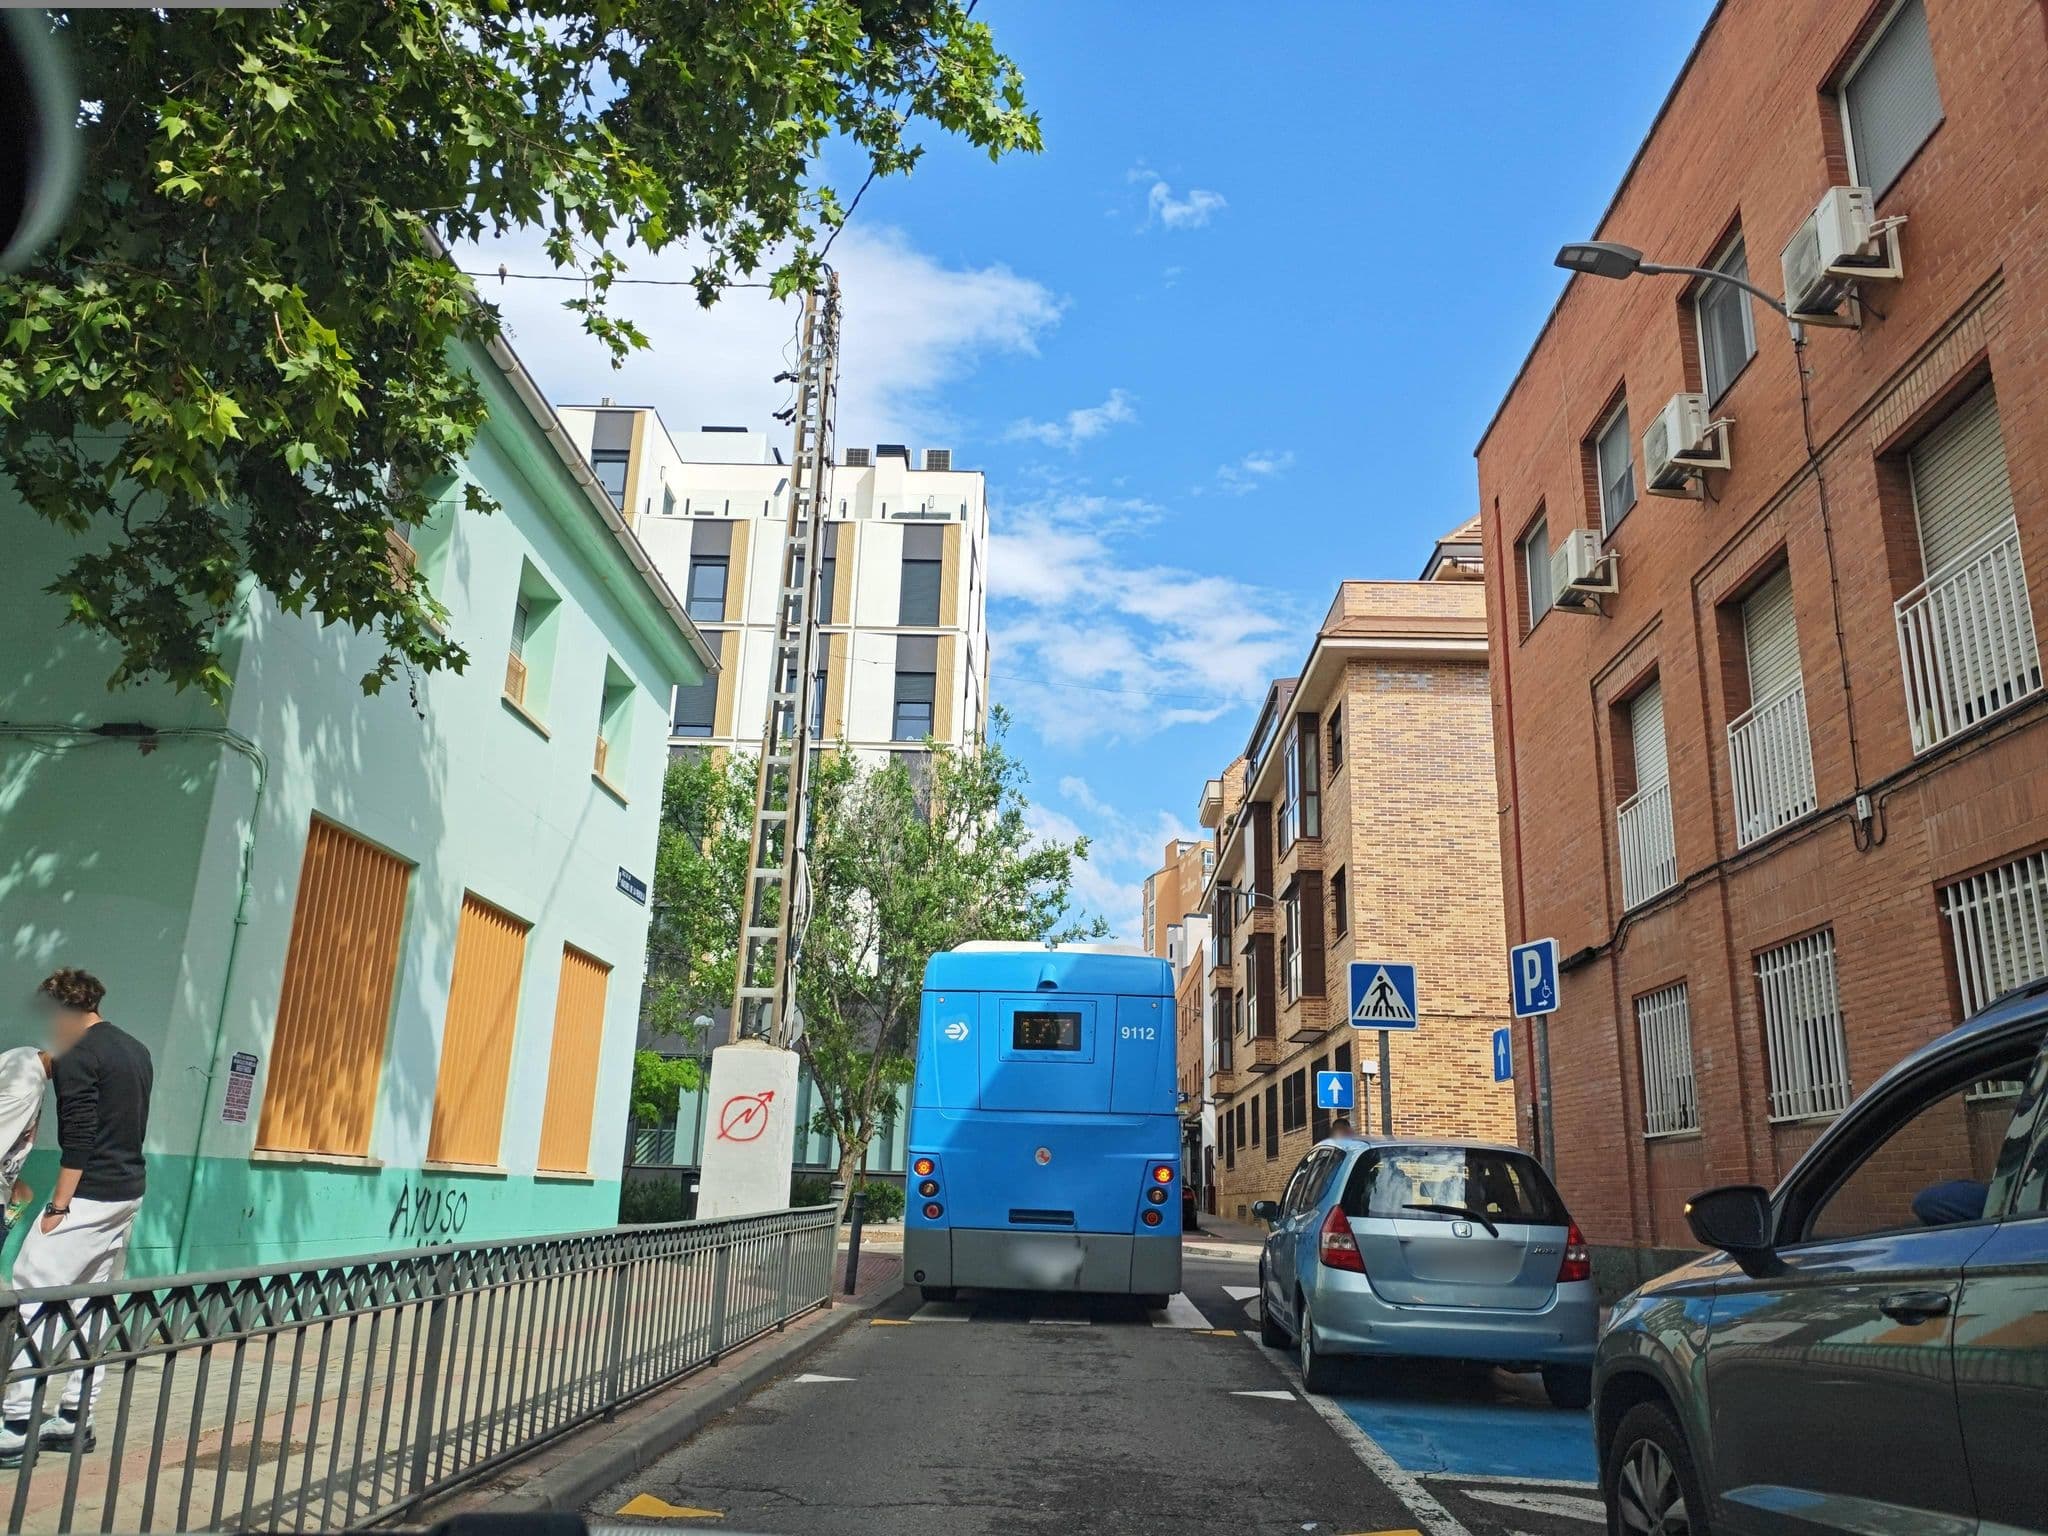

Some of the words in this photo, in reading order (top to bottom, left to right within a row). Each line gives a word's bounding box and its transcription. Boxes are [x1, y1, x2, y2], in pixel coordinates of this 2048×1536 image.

[1522, 950, 1542, 1006] P
[1121, 1026, 1155, 1040] 9112
[389, 1179, 468, 1239] AYUSO
